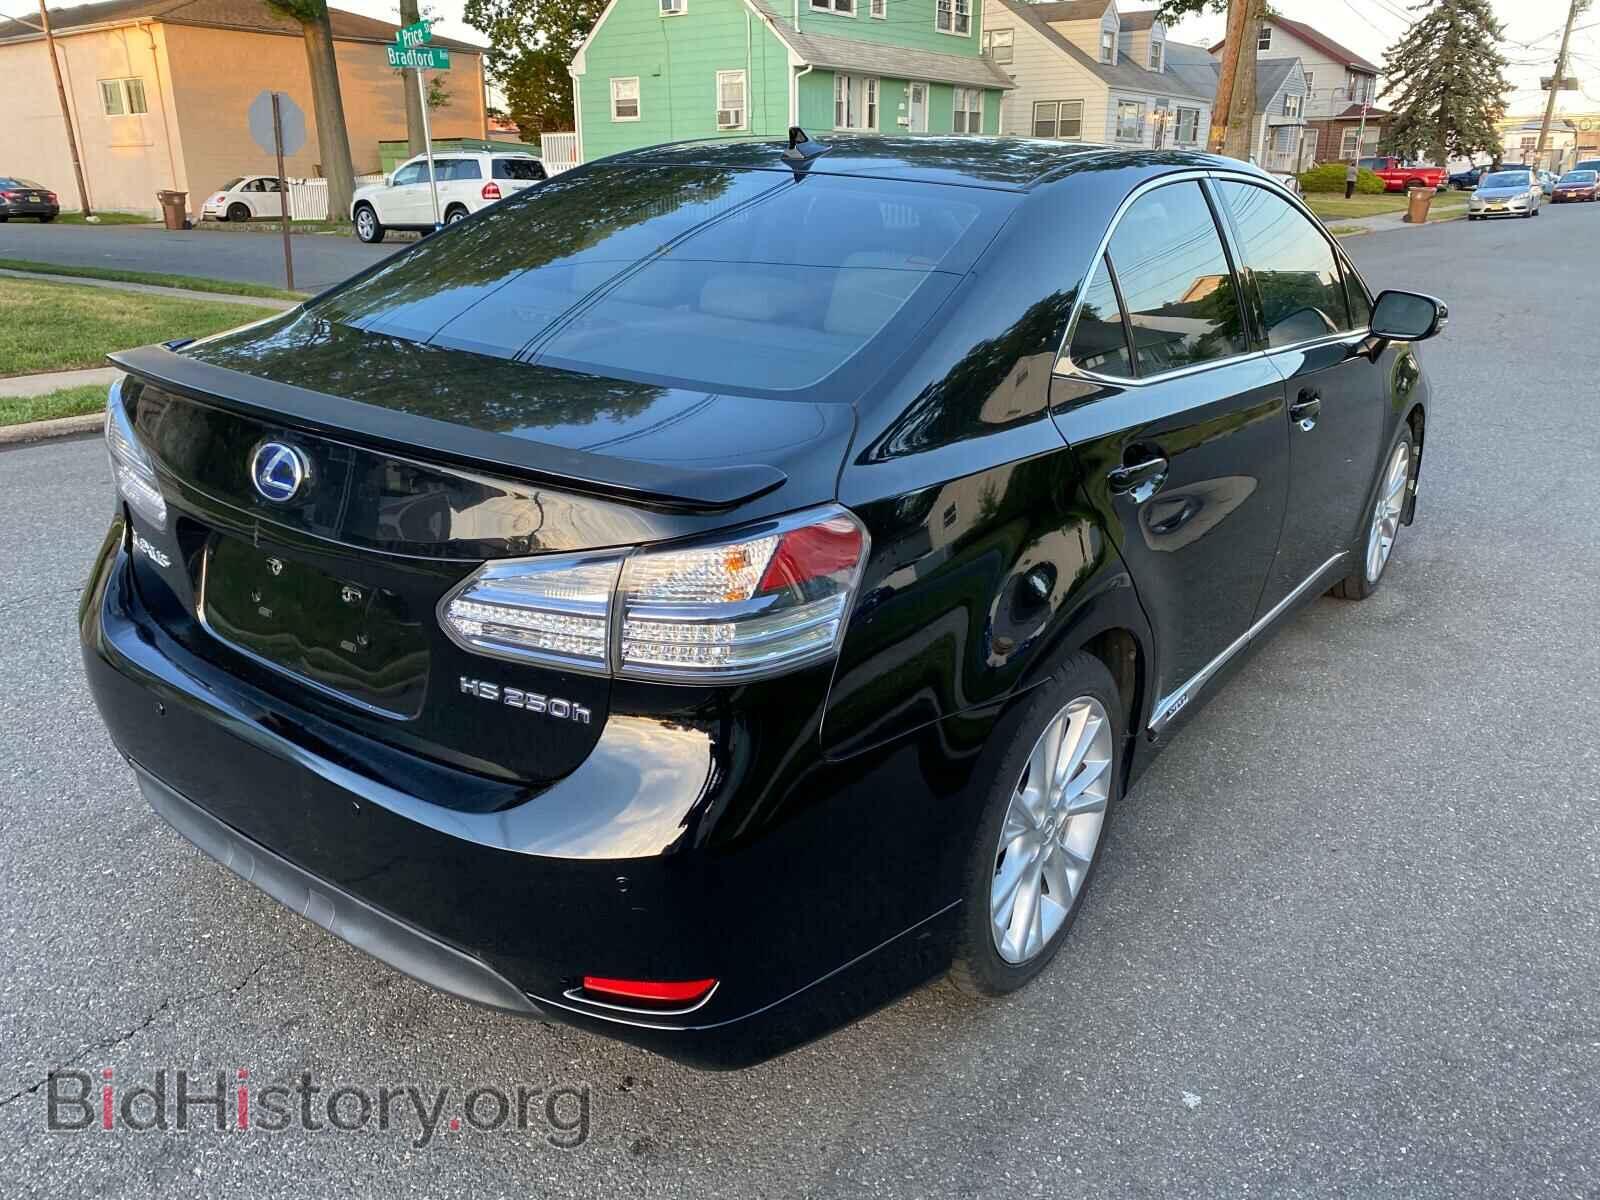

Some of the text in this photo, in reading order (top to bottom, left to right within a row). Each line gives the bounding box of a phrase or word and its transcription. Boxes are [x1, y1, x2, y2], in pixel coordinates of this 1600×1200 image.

[402, 28, 424, 48] Price
[387, 47, 435, 66] Bradford
[460, 676, 591, 724] HS 250h
